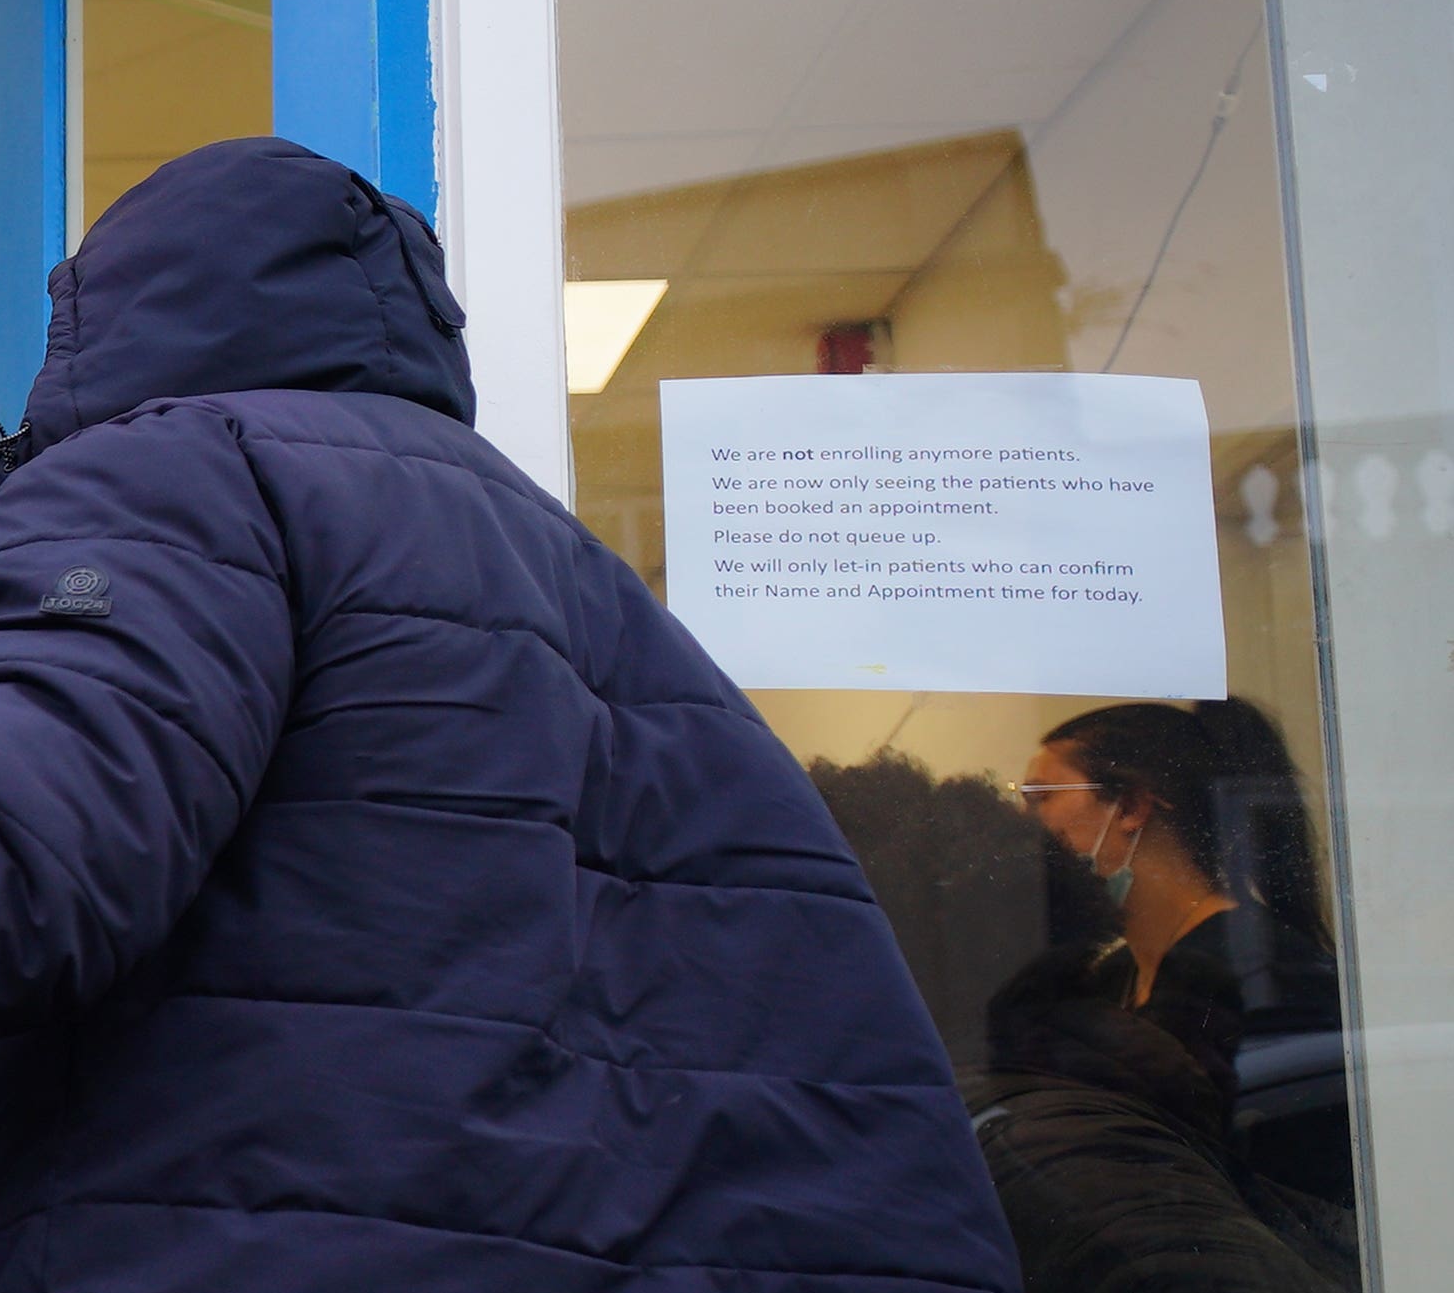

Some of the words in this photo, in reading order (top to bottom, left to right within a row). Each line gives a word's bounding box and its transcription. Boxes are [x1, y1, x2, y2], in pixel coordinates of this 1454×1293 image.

[711, 449, 741, 461] We
[747, 451, 776, 461] are
[782, 449, 814, 461] not
[820, 446, 903, 463] enrolling
[908, 449, 992, 463] anymore
[999, 447, 1080, 462] patients.
[712, 477, 742, 490] We
[748, 479, 778, 490] are
[784, 478, 823, 489] now
[829, 476, 870, 492] only
[875, 476, 936, 492] seeing
[942, 476, 973, 489] the
[980, 476, 1056, 492] patients
[1062, 477, 1103, 491] who
[1109, 478, 1154, 492] have
[713, 501, 759, 514] been
[765, 500, 834, 514] booked
[840, 503, 862, 514] an
[869, 500, 999, 516] appointment.
[714, 530, 773, 543] Please
[779, 529, 803, 543] do
[809, 531, 840, 543] not
[846, 532, 906, 546] queue
[912, 533, 941, 546] up.
[714, 559, 744, 573] We
[751, 559, 782, 572] will
[788, 559, 828, 575] only
[834, 559, 881, 573] let-in
[889, 559, 965, 575] patients
[972, 559, 1013, 574] who
[1019, 563, 1052, 574] can
[1059, 560, 1133, 575] confirm
[715, 584, 759, 598] their
[766, 584, 820, 598] Name
[826, 584, 861, 598] and
[867, 584, 995, 600] Appointment
[1002, 585, 1045, 599] time
[1052, 585, 1079, 600] for
[1085, 587, 1143, 605] today.
